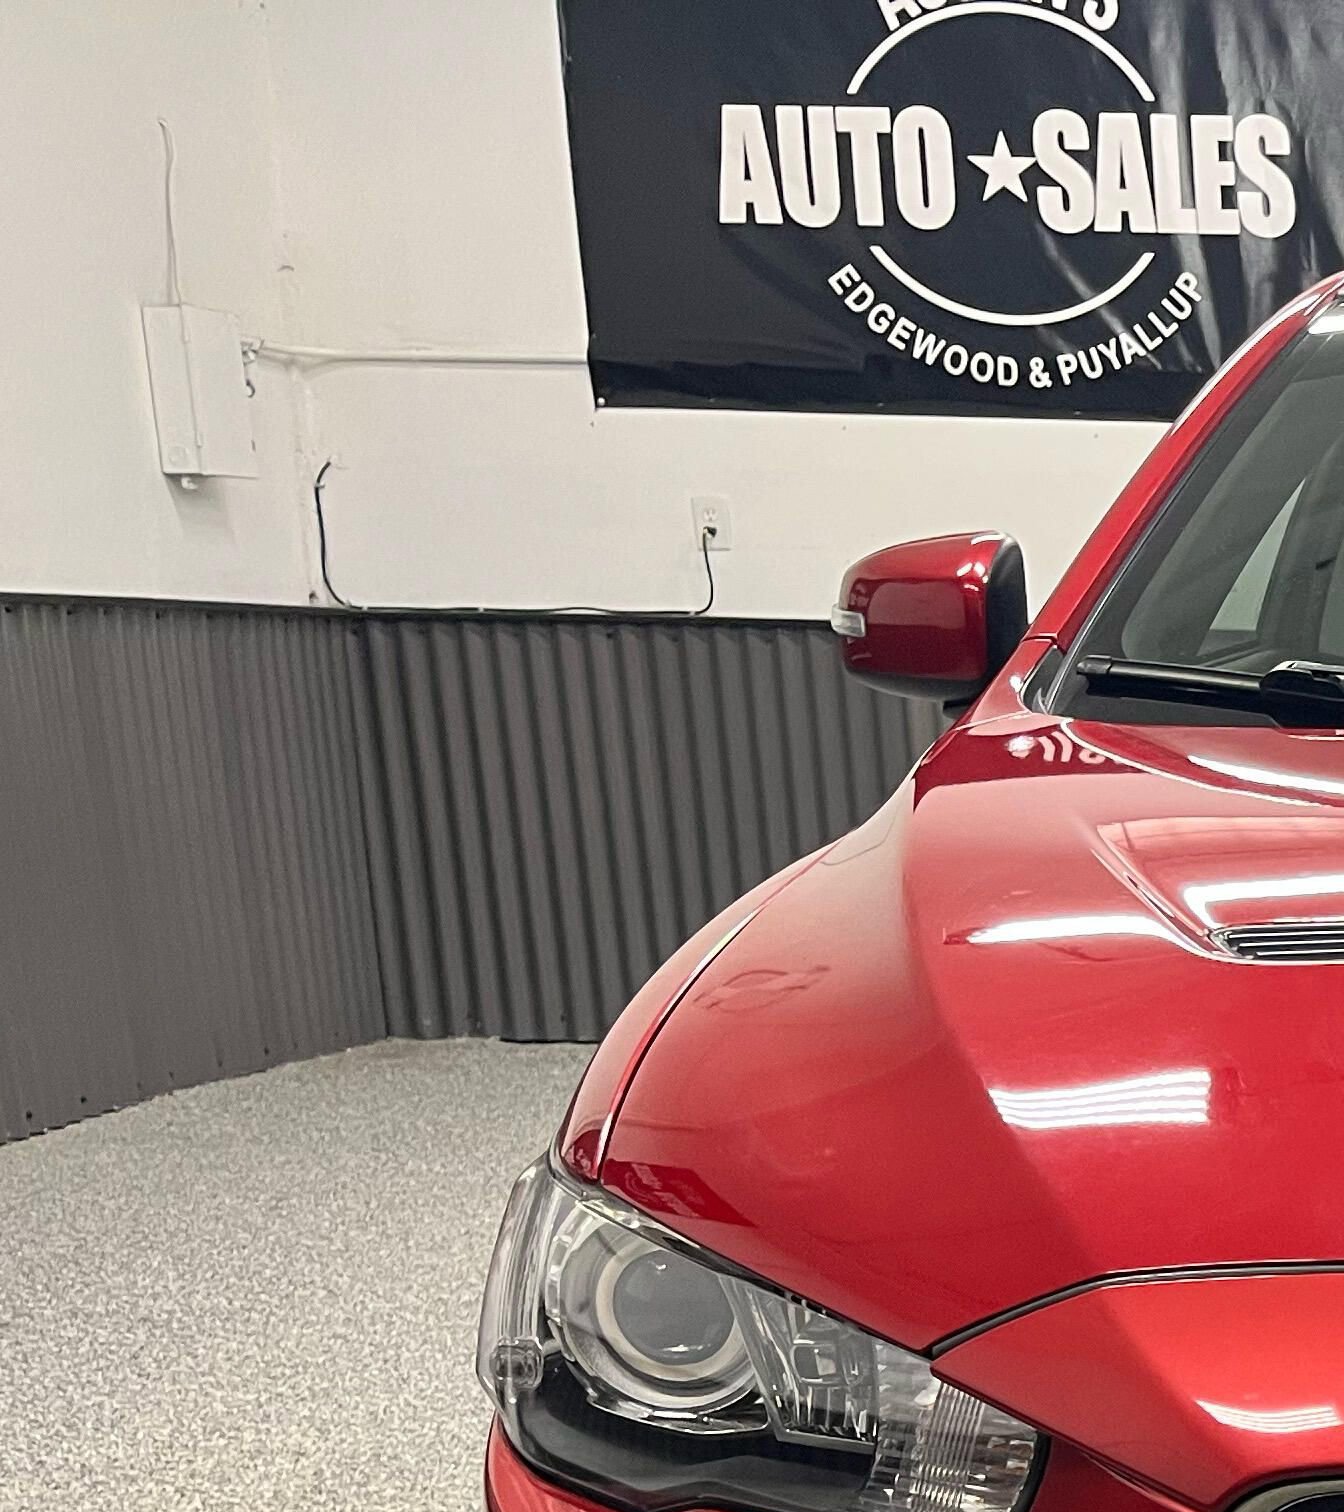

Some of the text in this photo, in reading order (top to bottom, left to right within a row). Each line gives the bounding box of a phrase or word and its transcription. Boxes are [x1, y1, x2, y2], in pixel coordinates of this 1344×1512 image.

[718, 104, 1296, 239] AUTO SALES
[827, 262, 1206, 389] EDGEWOOD & PUYALLUP
